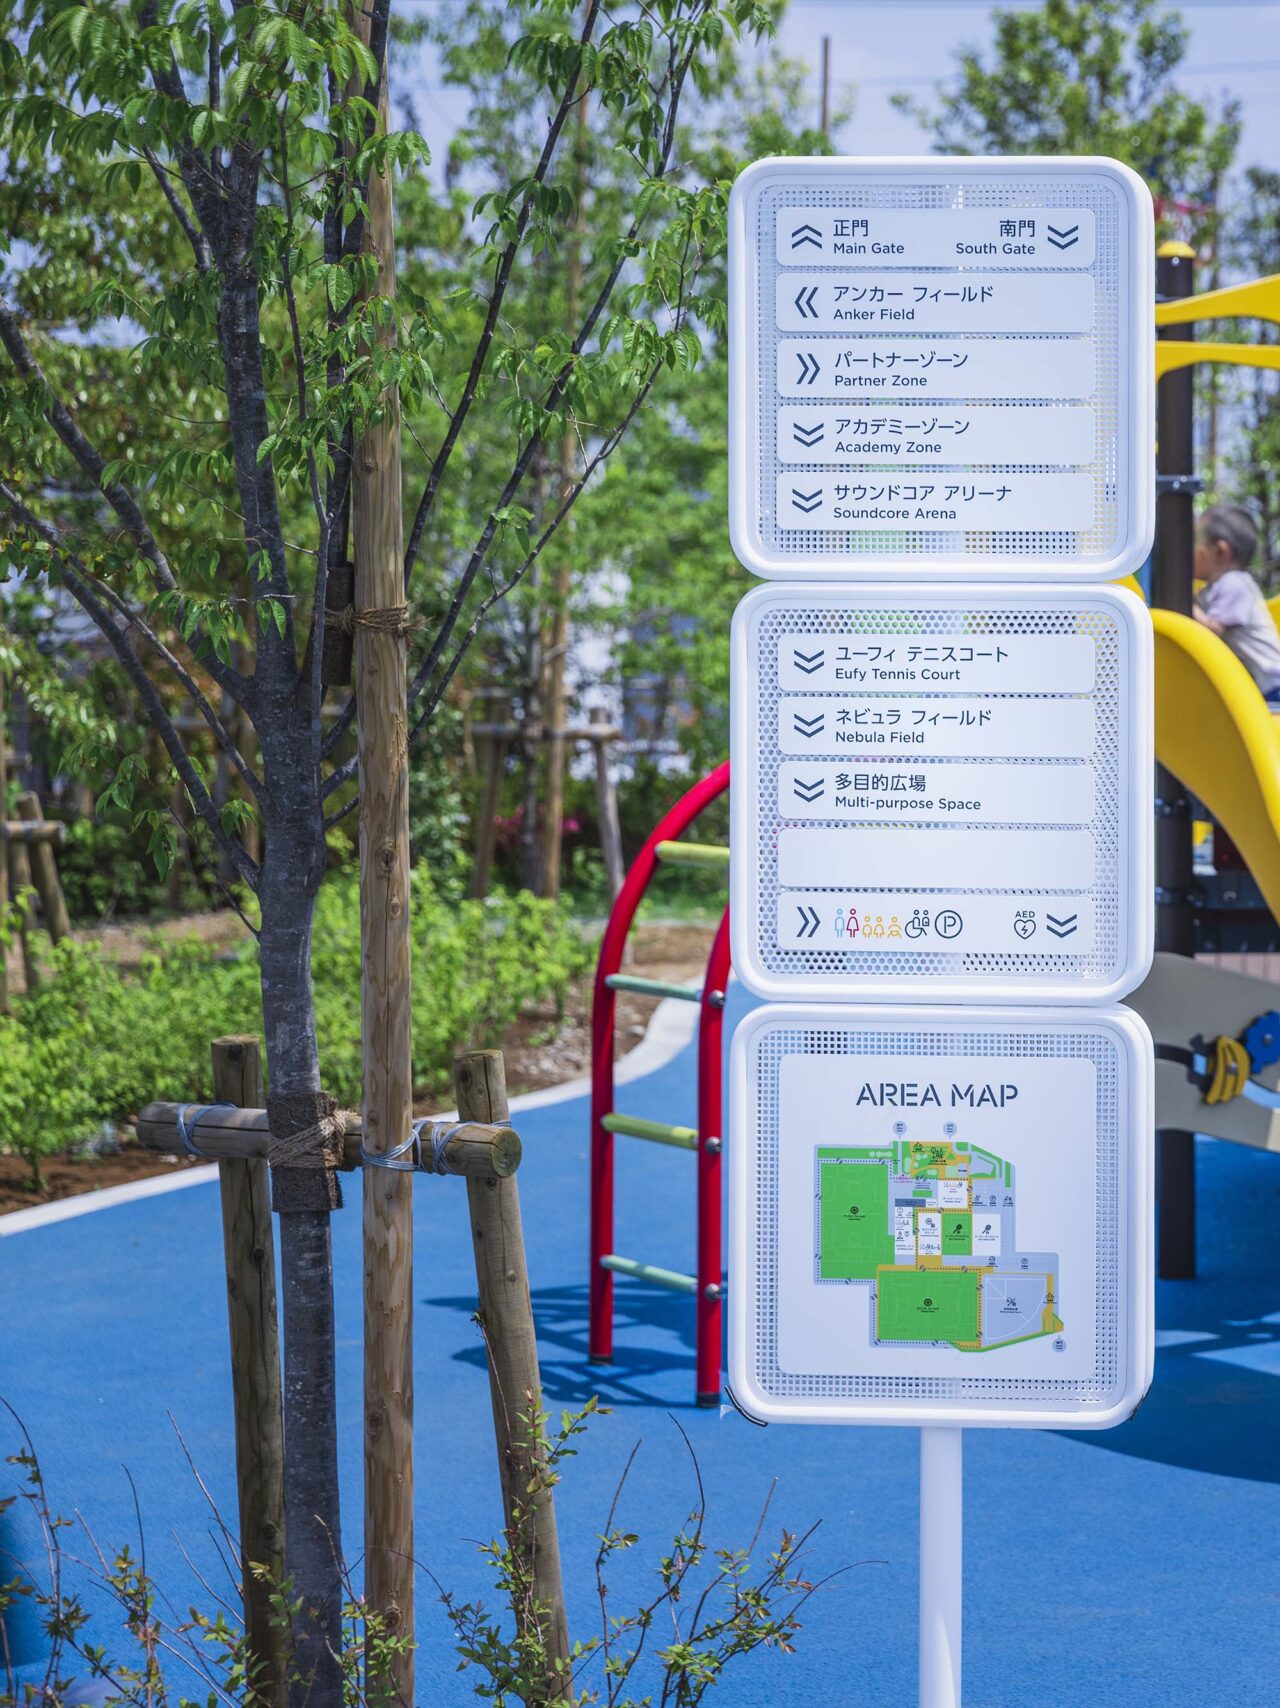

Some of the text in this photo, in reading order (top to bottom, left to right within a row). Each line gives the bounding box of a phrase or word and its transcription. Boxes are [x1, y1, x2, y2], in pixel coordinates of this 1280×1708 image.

[832, 219, 869, 238] 正門
[999, 219, 1036, 238] 南門
[833, 242, 905, 255] Main Gate
[955, 242, 1036, 255] South Gate
[833, 285, 994, 303] アンカー フィールド
[833, 308, 915, 321] Anker Field
[834, 350, 969, 369] パートナーゾーン
[834, 374, 928, 387] Partner Zone
[835, 417, 970, 436] アカデミーゾーン
[834, 440, 942, 455] Academy Zone
[833, 484, 1013, 502] サウンドコア アリーナ
[833, 506, 957, 520] Soundcore Arena
[835, 646, 1009, 663] ユーフィ テニスコート
[835, 667, 961, 682] Eufy Tennis Court
[835, 707, 992, 727] ネビュラ フィールド
[835, 730, 925, 744] Nebula Field
[834, 772, 927, 793] 多目的広場
[835, 795, 982, 812] Multi-purpose Space
[1014, 910, 1036, 919] AED
[855, 1082, 1019, 1108] AREA MAP
